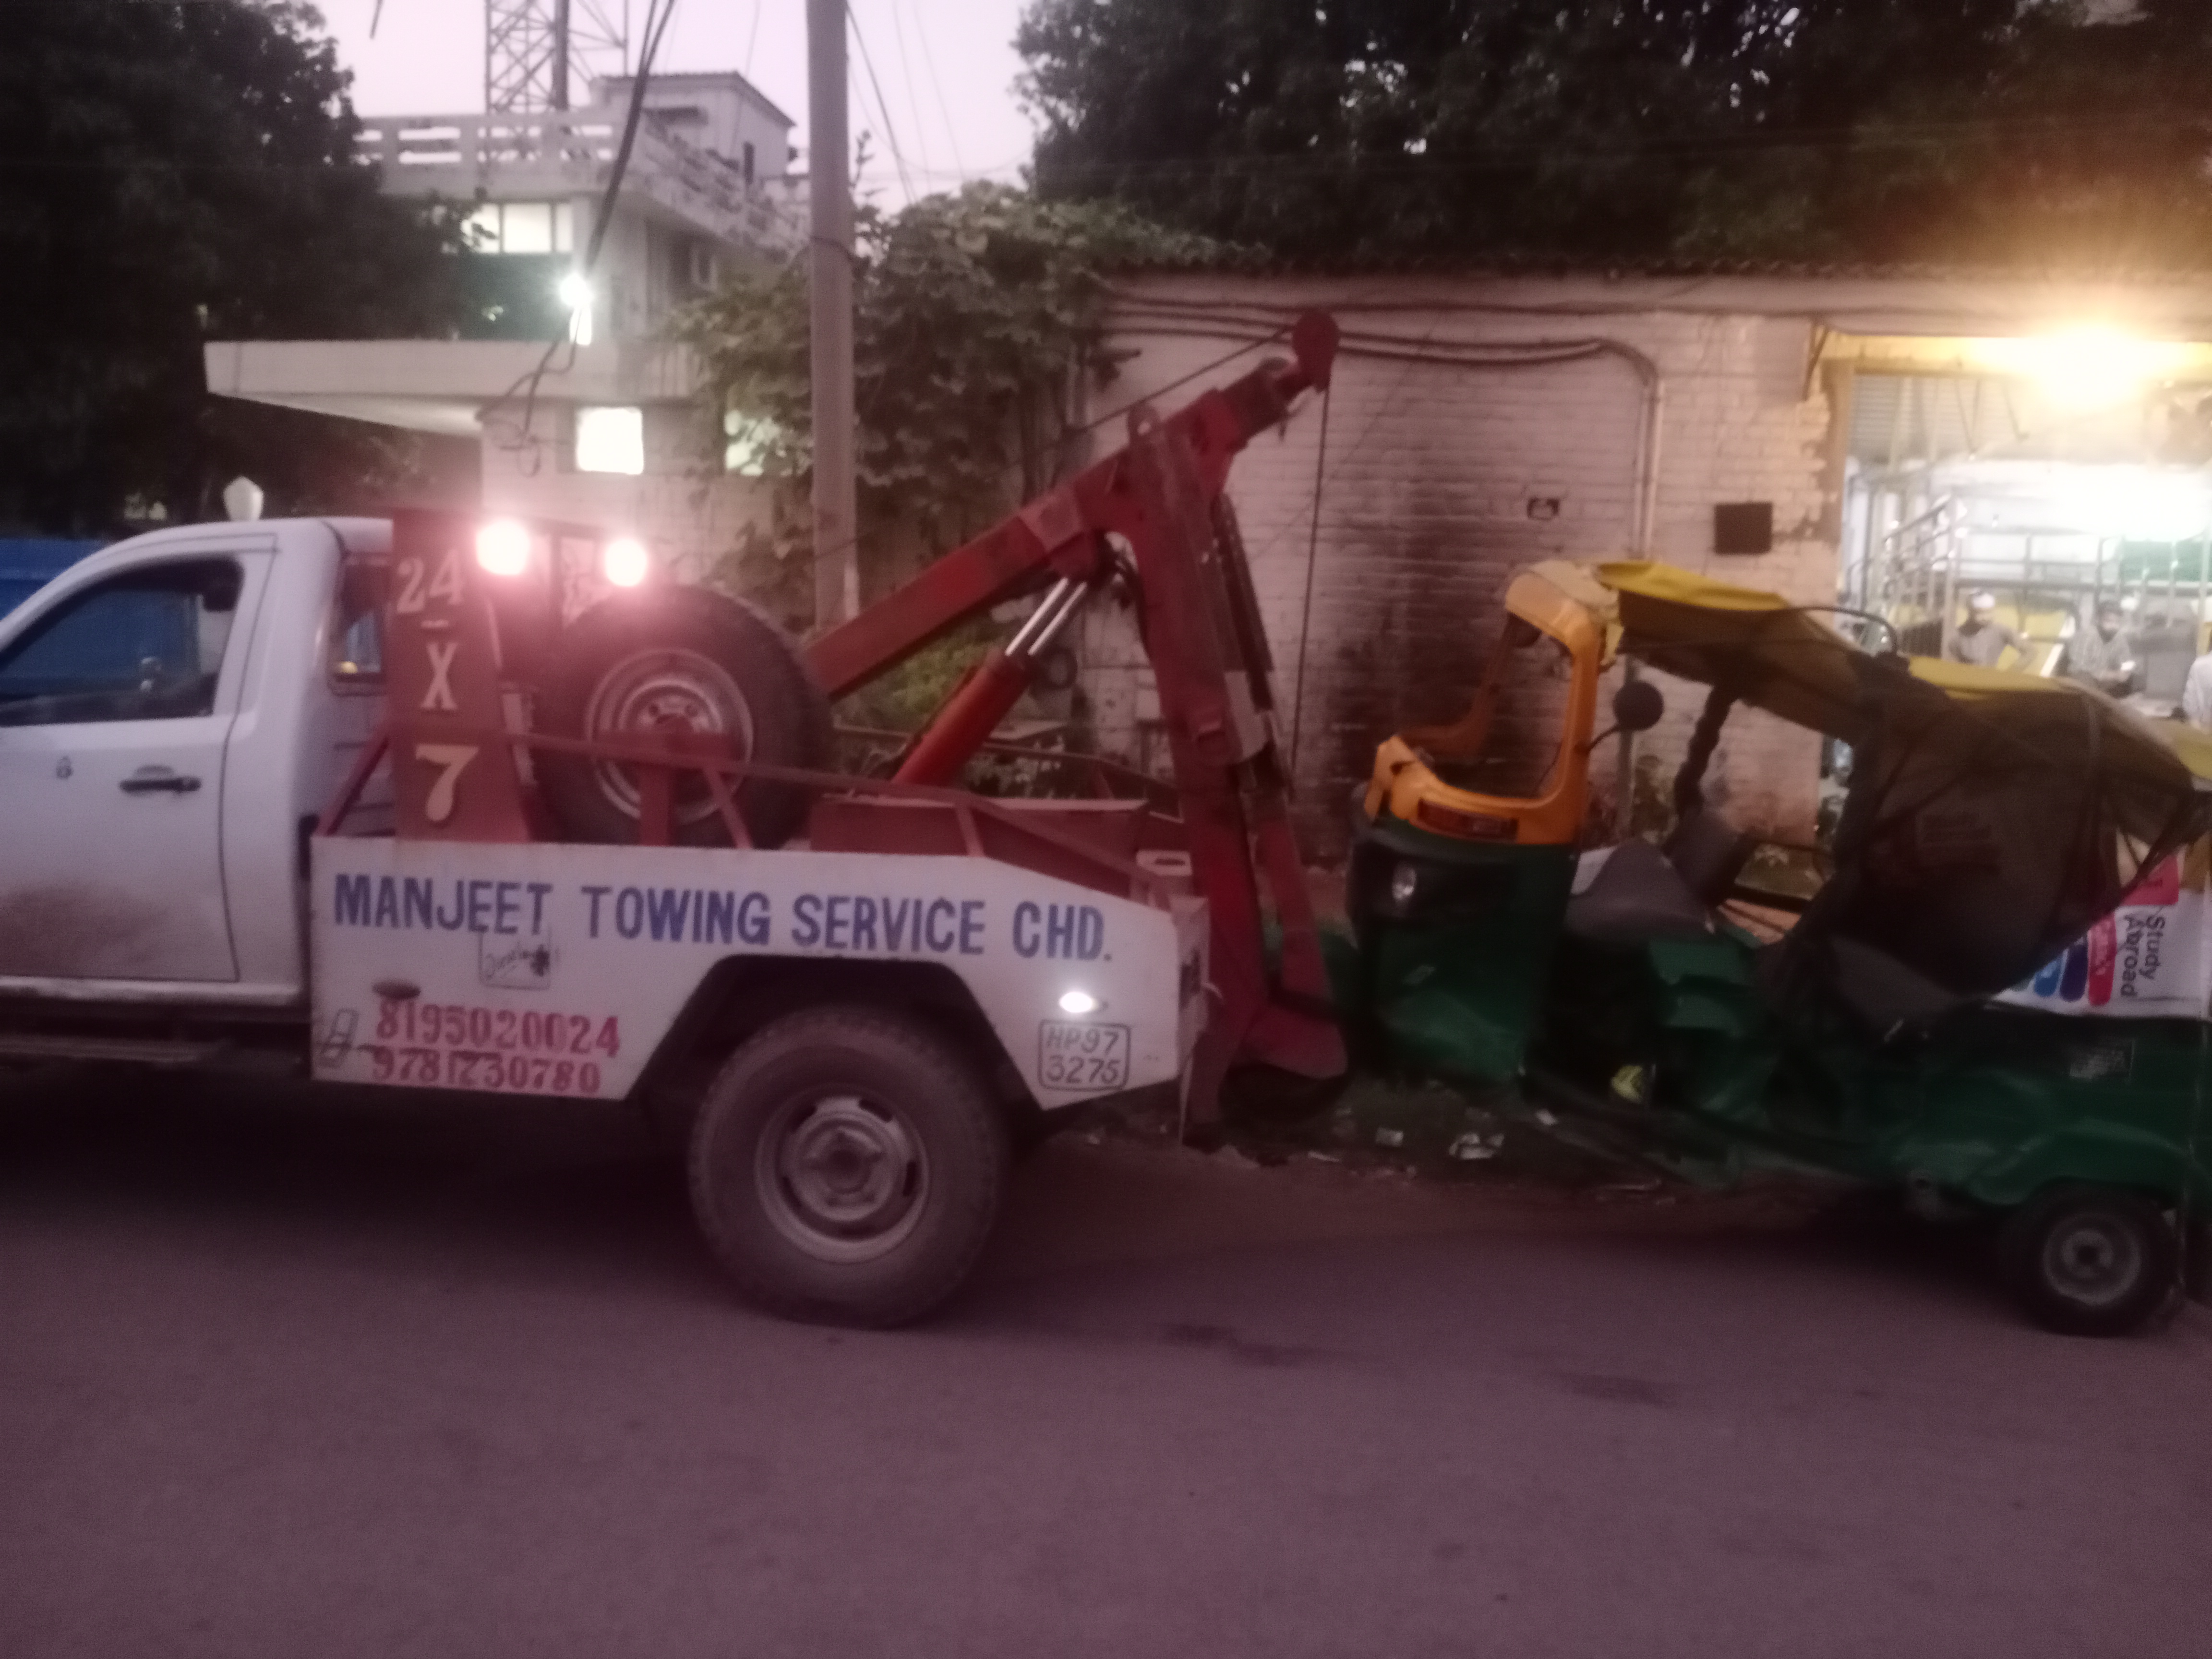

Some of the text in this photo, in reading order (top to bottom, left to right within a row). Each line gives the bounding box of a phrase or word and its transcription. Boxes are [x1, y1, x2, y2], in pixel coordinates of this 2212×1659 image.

[396, 547, 464, 613] 24
[420, 641, 458, 711] X
[415, 743, 479, 822] 7
[334, 873, 553, 934] MANJEET
[581, 886, 771, 945] TOWING
[791, 893, 986, 954] SERVICE
[2139, 914, 2165, 980] Study
[2120, 914, 2145, 997] Abroad
